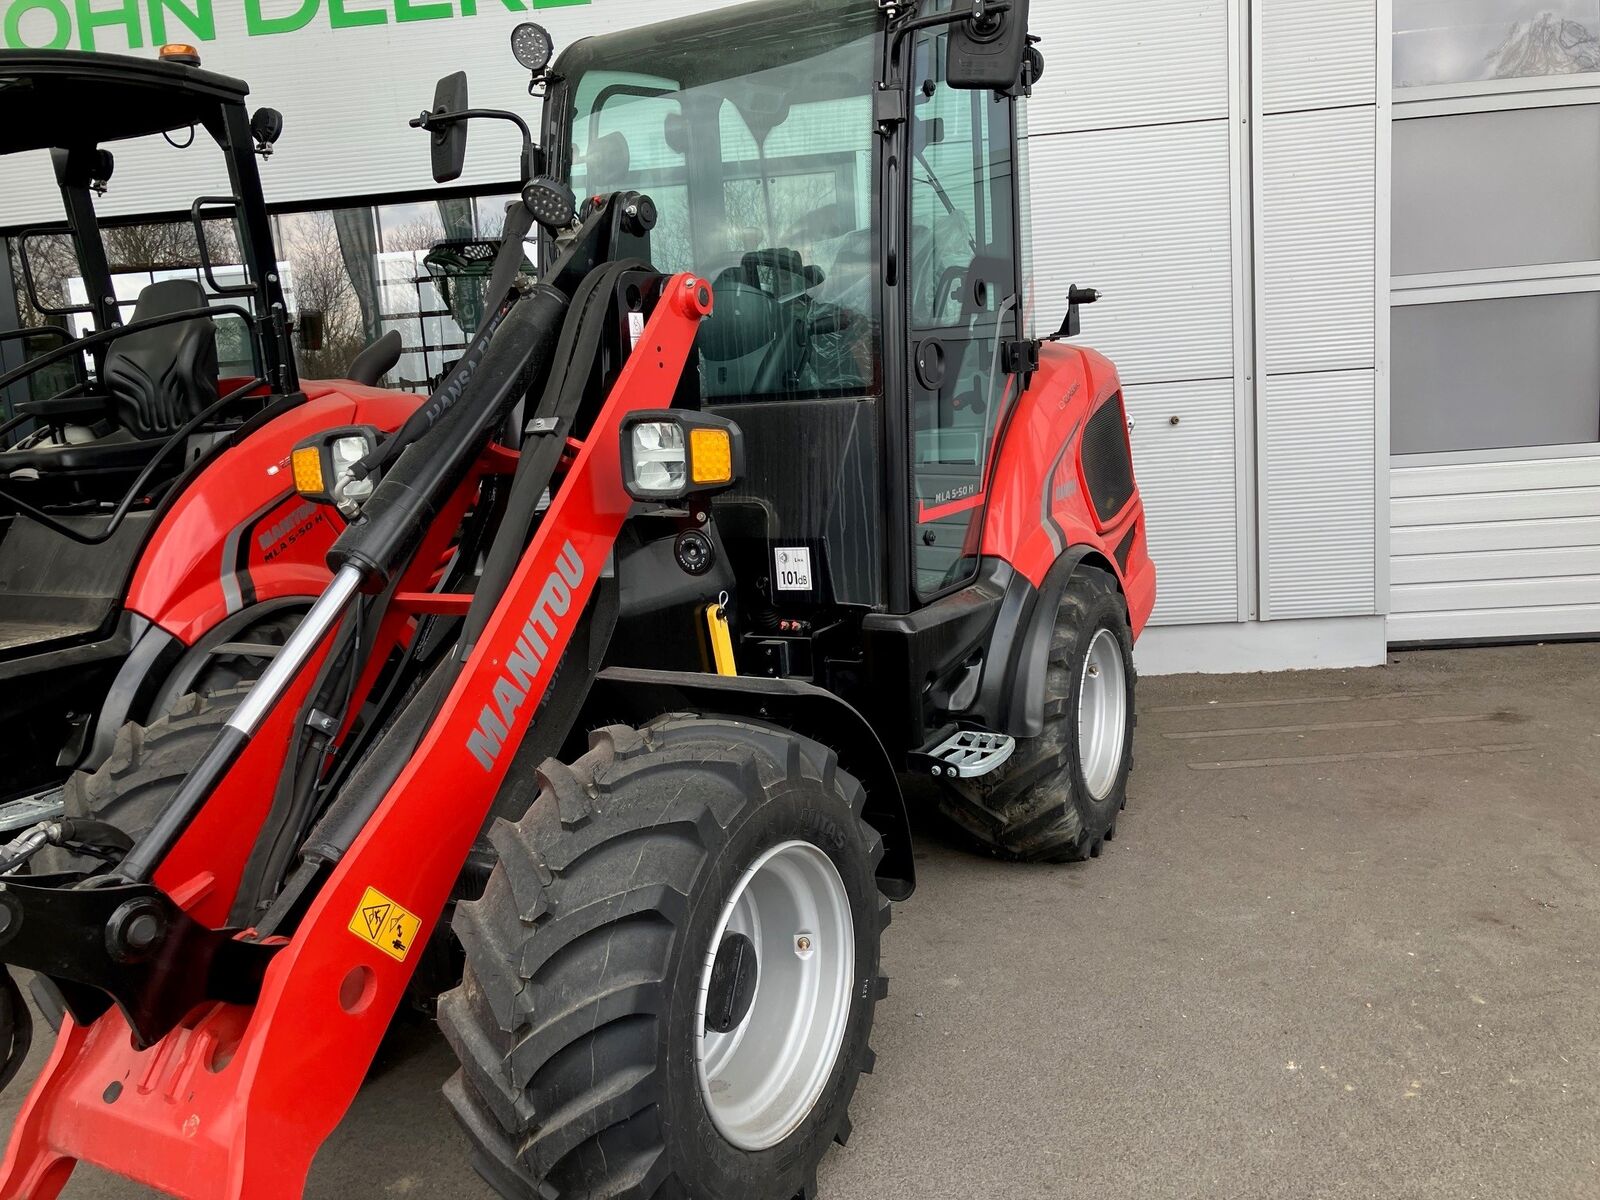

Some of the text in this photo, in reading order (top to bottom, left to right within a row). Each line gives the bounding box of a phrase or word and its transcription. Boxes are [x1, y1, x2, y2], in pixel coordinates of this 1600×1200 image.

[935, 490, 951, 503] MLA
[951, 486, 968, 498] 5-50
[264, 541, 287, 562] MLA
[466, 539, 585, 773] MANITOU
